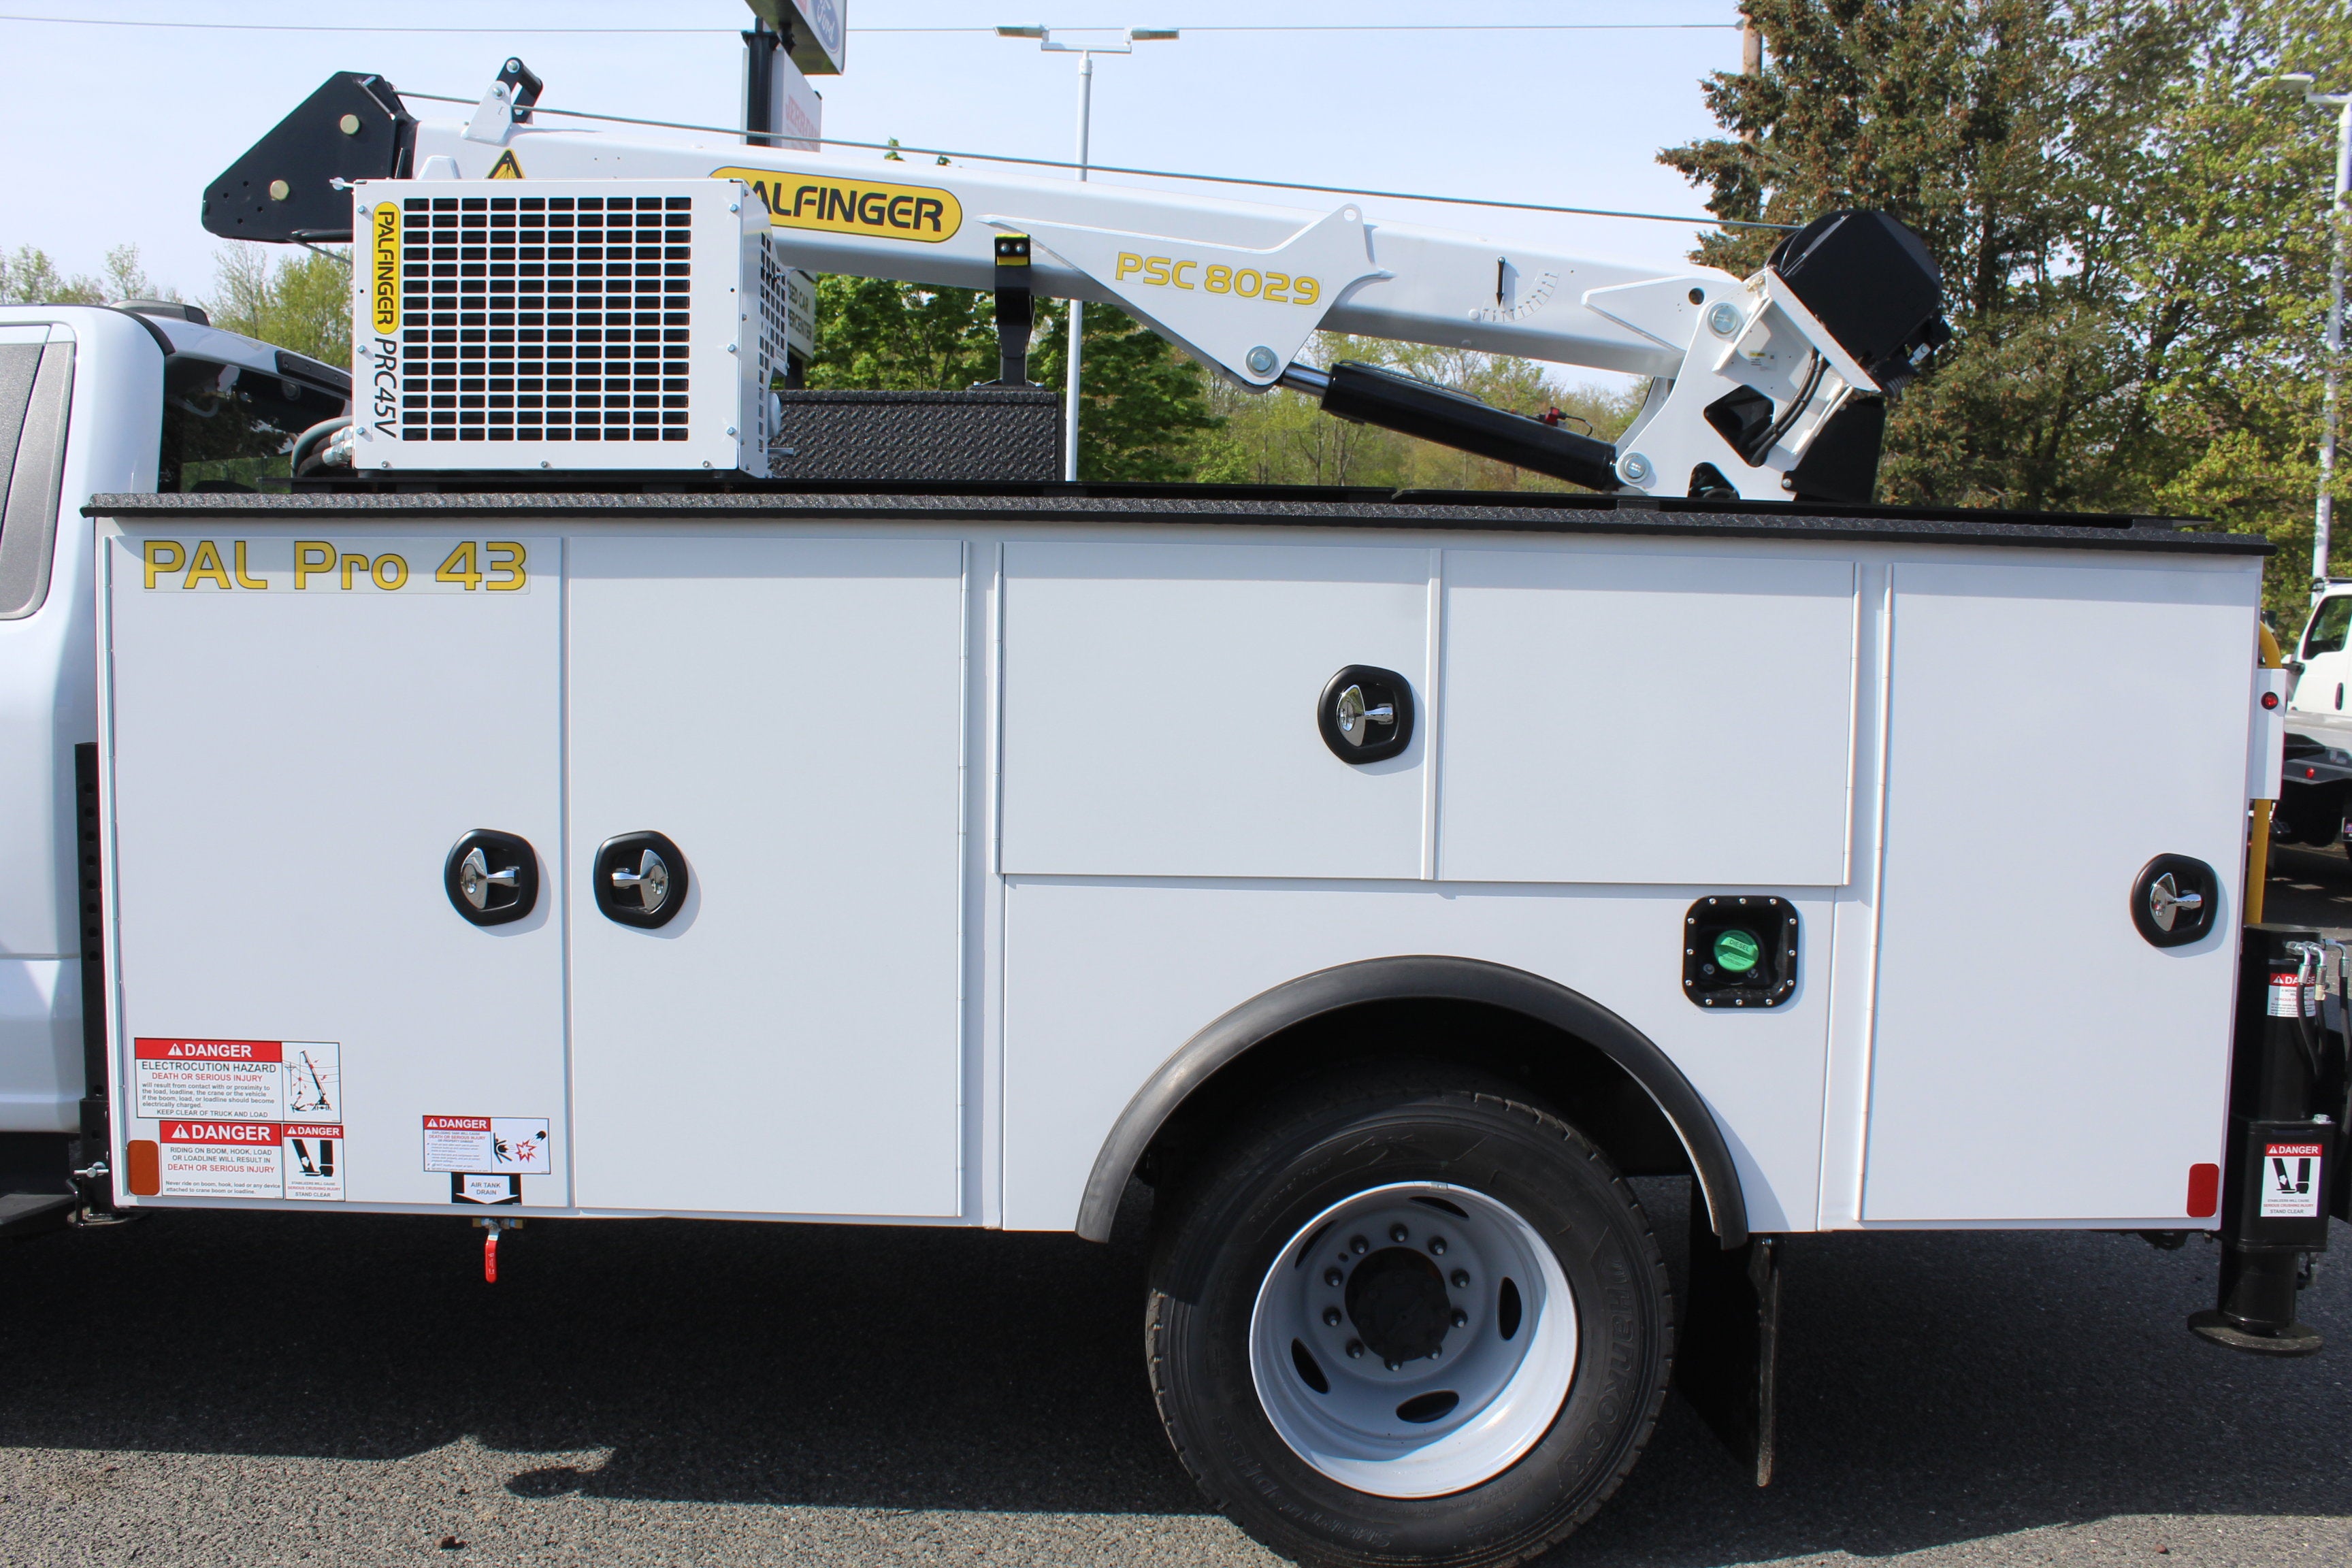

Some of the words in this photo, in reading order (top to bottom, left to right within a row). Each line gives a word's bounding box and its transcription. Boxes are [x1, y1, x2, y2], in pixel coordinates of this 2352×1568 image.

[753, 180, 943, 232] ALFINGER
[377, 211, 395, 325] PALFINGER
[1115, 252, 1197, 290] PSC
[1204, 264, 1320, 306] 8029
[799, 291, 808, 314] CAR
[374, 337, 397, 439] PRC45V
[144, 540, 267, 589] PAL
[294, 541, 408, 590] Pro
[435, 541, 526, 591] 43
[1729, 939, 1749, 952] DIESEL
[184, 1043, 252, 1058] DANGER
[142, 1061, 230, 1072] ELECTROCUTION
[233, 1063, 276, 1073] HAZARD
[152, 1072, 179, 1080] DEATH
[195, 1073, 231, 1081] SERIOUS
[233, 1074, 263, 1082] INJURY
[297, 1126, 340, 1136] DANGER
[439, 1118, 487, 1129] DANGER
[191, 1124, 272, 1141] DANGER
[2278, 1145, 2319, 1154] DANGER
[210, 1164, 245, 1173] SERIOUS
